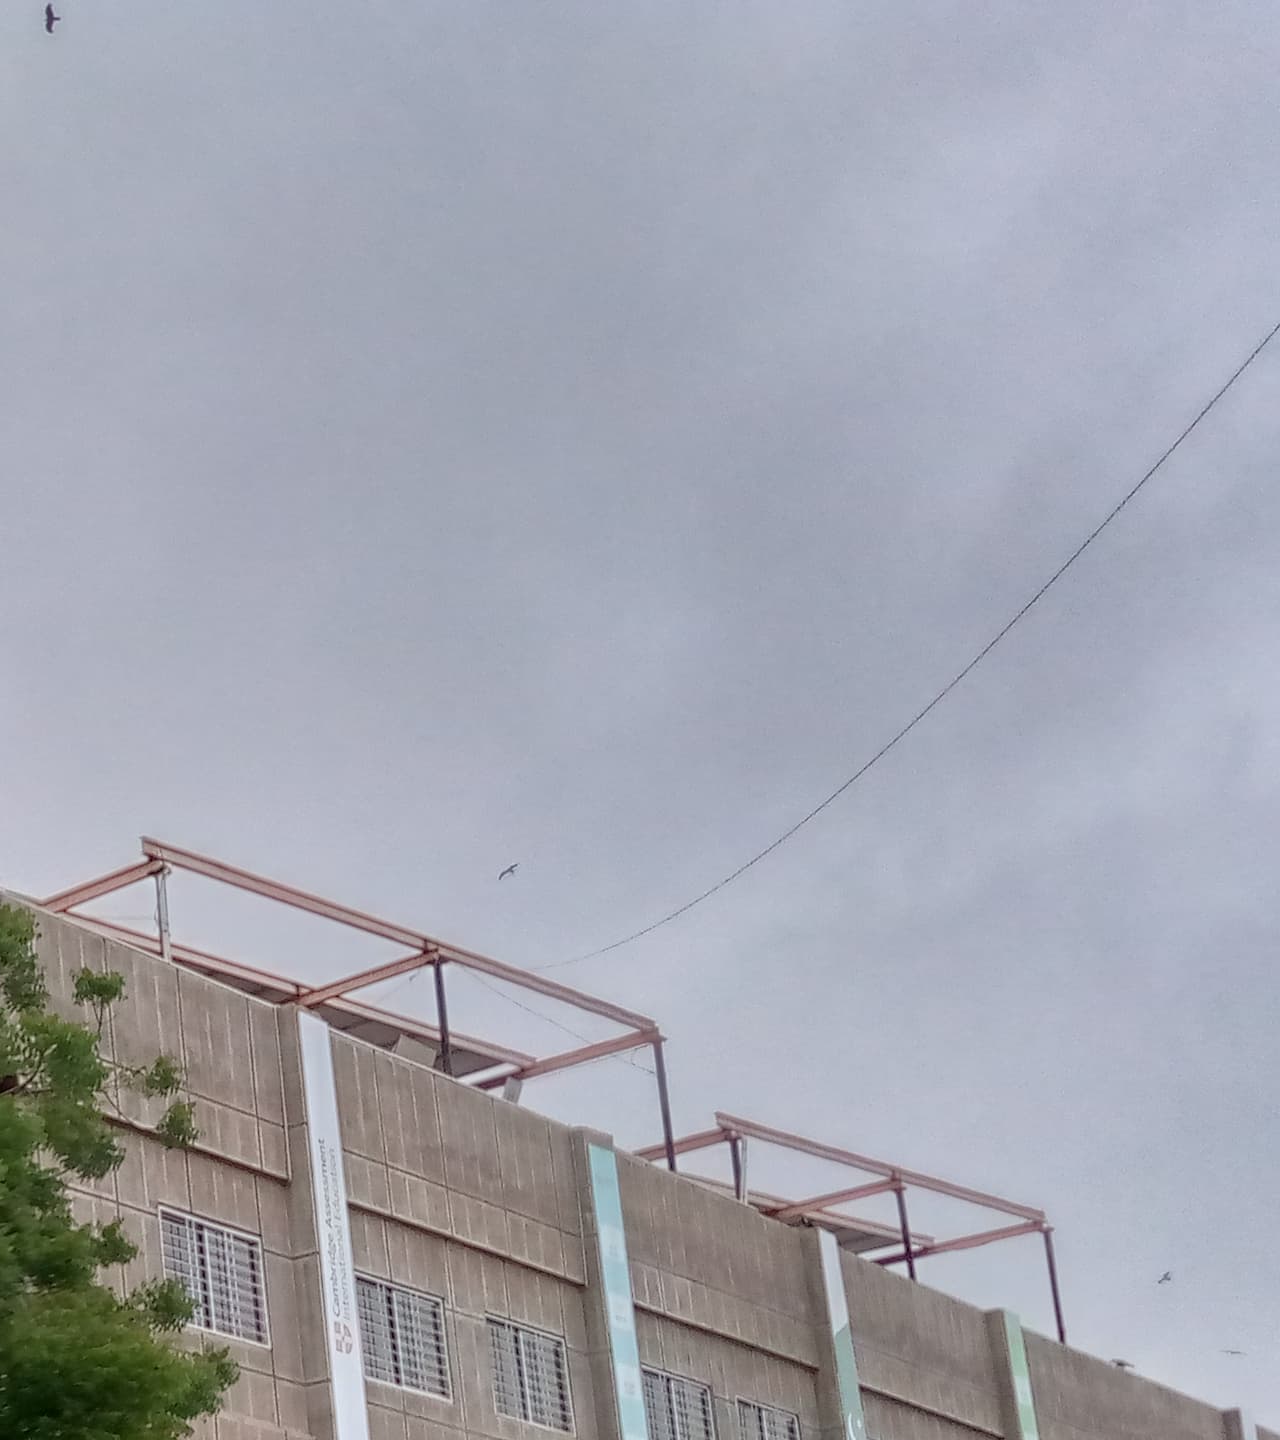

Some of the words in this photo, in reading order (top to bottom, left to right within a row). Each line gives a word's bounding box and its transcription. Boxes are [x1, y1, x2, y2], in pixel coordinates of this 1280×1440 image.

[318, 1138, 332, 1229] Assessment
[329, 1148, 341, 1223] Education
[327, 1235, 341, 1317] Cambridge
[335, 1225, 350, 1321] International
